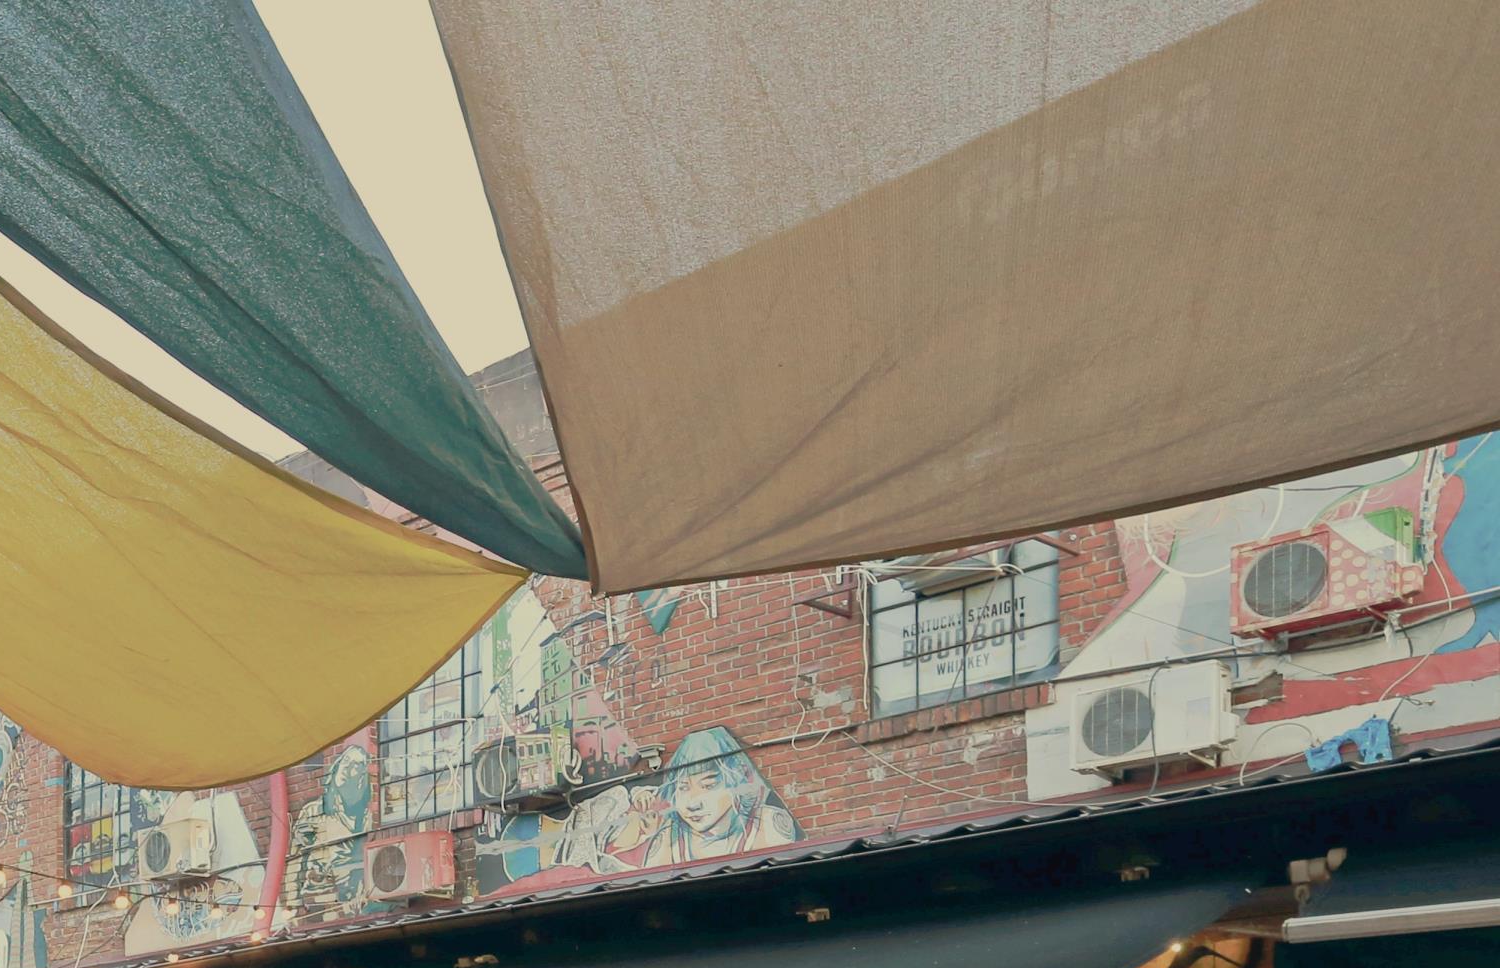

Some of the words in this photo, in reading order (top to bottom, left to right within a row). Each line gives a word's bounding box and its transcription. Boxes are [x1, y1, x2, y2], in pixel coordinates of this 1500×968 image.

[902, 612, 963, 638] KENTUCKY
[902, 613, 1025, 668] BOURBON
[937, 652, 990, 675] WHIKEY
